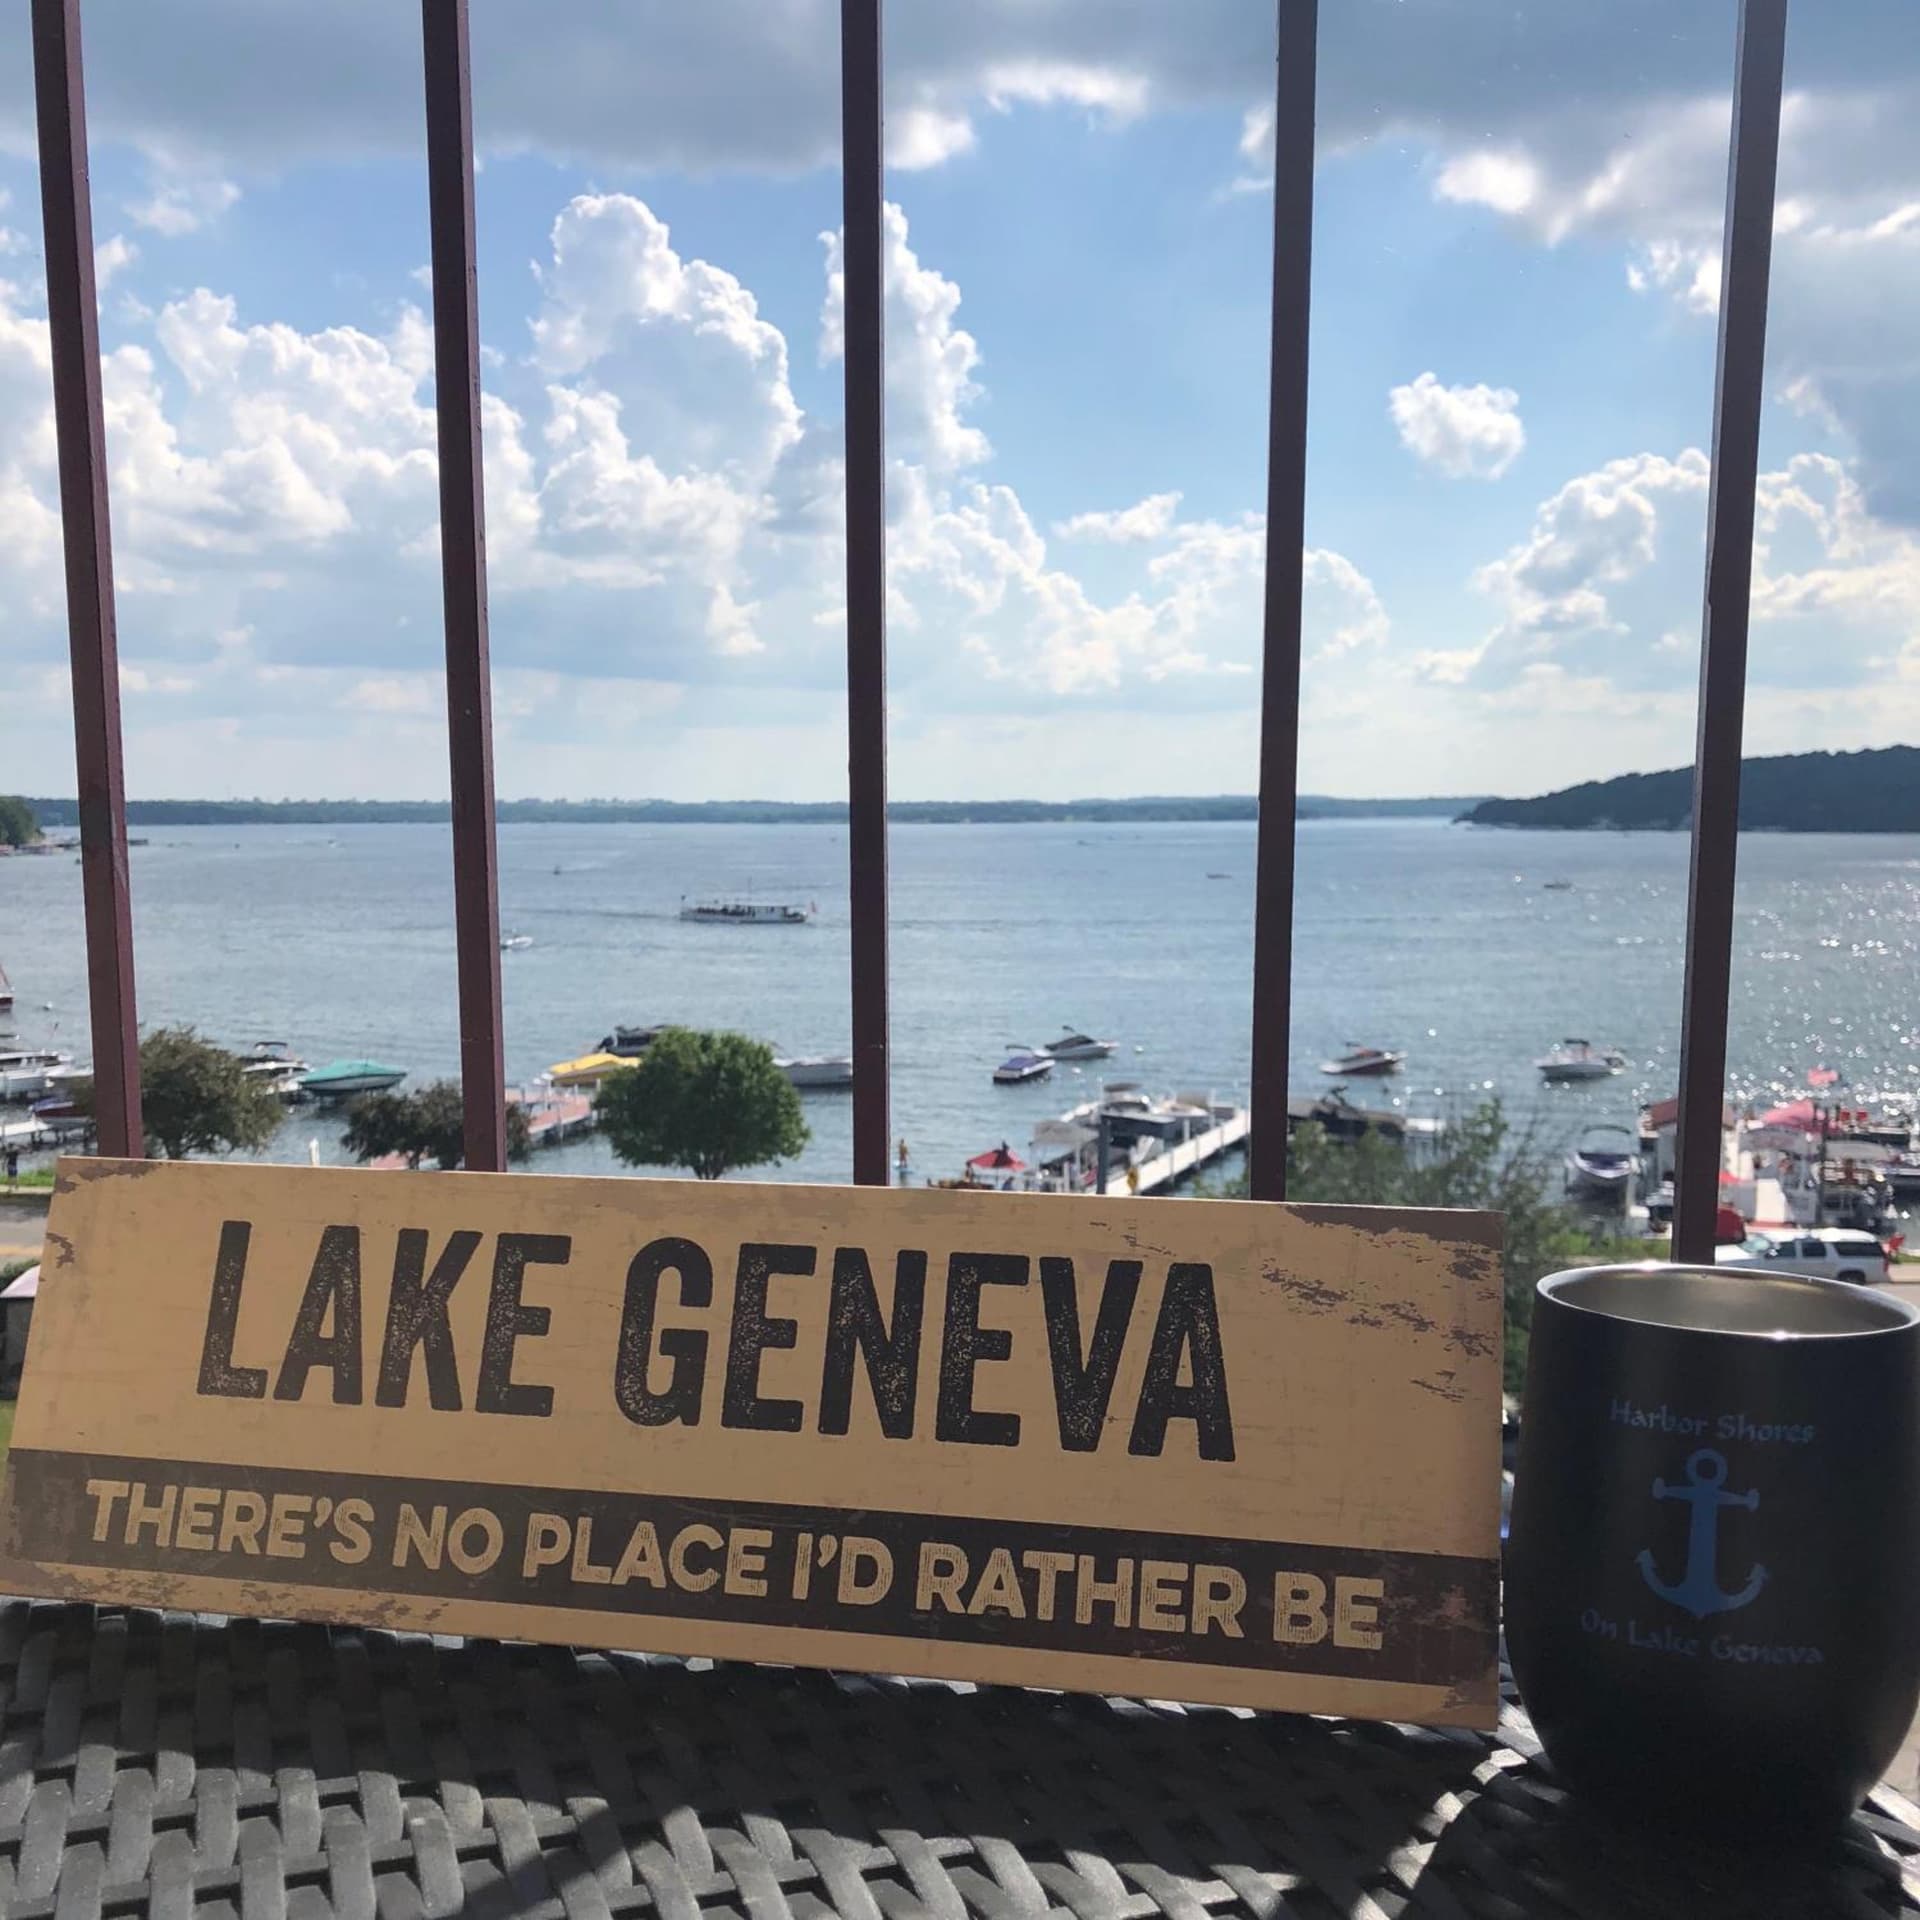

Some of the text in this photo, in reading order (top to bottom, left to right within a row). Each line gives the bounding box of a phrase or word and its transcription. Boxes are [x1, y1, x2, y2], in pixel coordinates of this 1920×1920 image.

[197, 1220, 1236, 1462] LAKE GENEVA
[1608, 1399, 1816, 1444] Harbor Shores
[85, 1478, 1384, 1650] THERE'S NO PLACE I'D RATHER BE
[1580, 1608, 1824, 1664] On Lake Geneva
